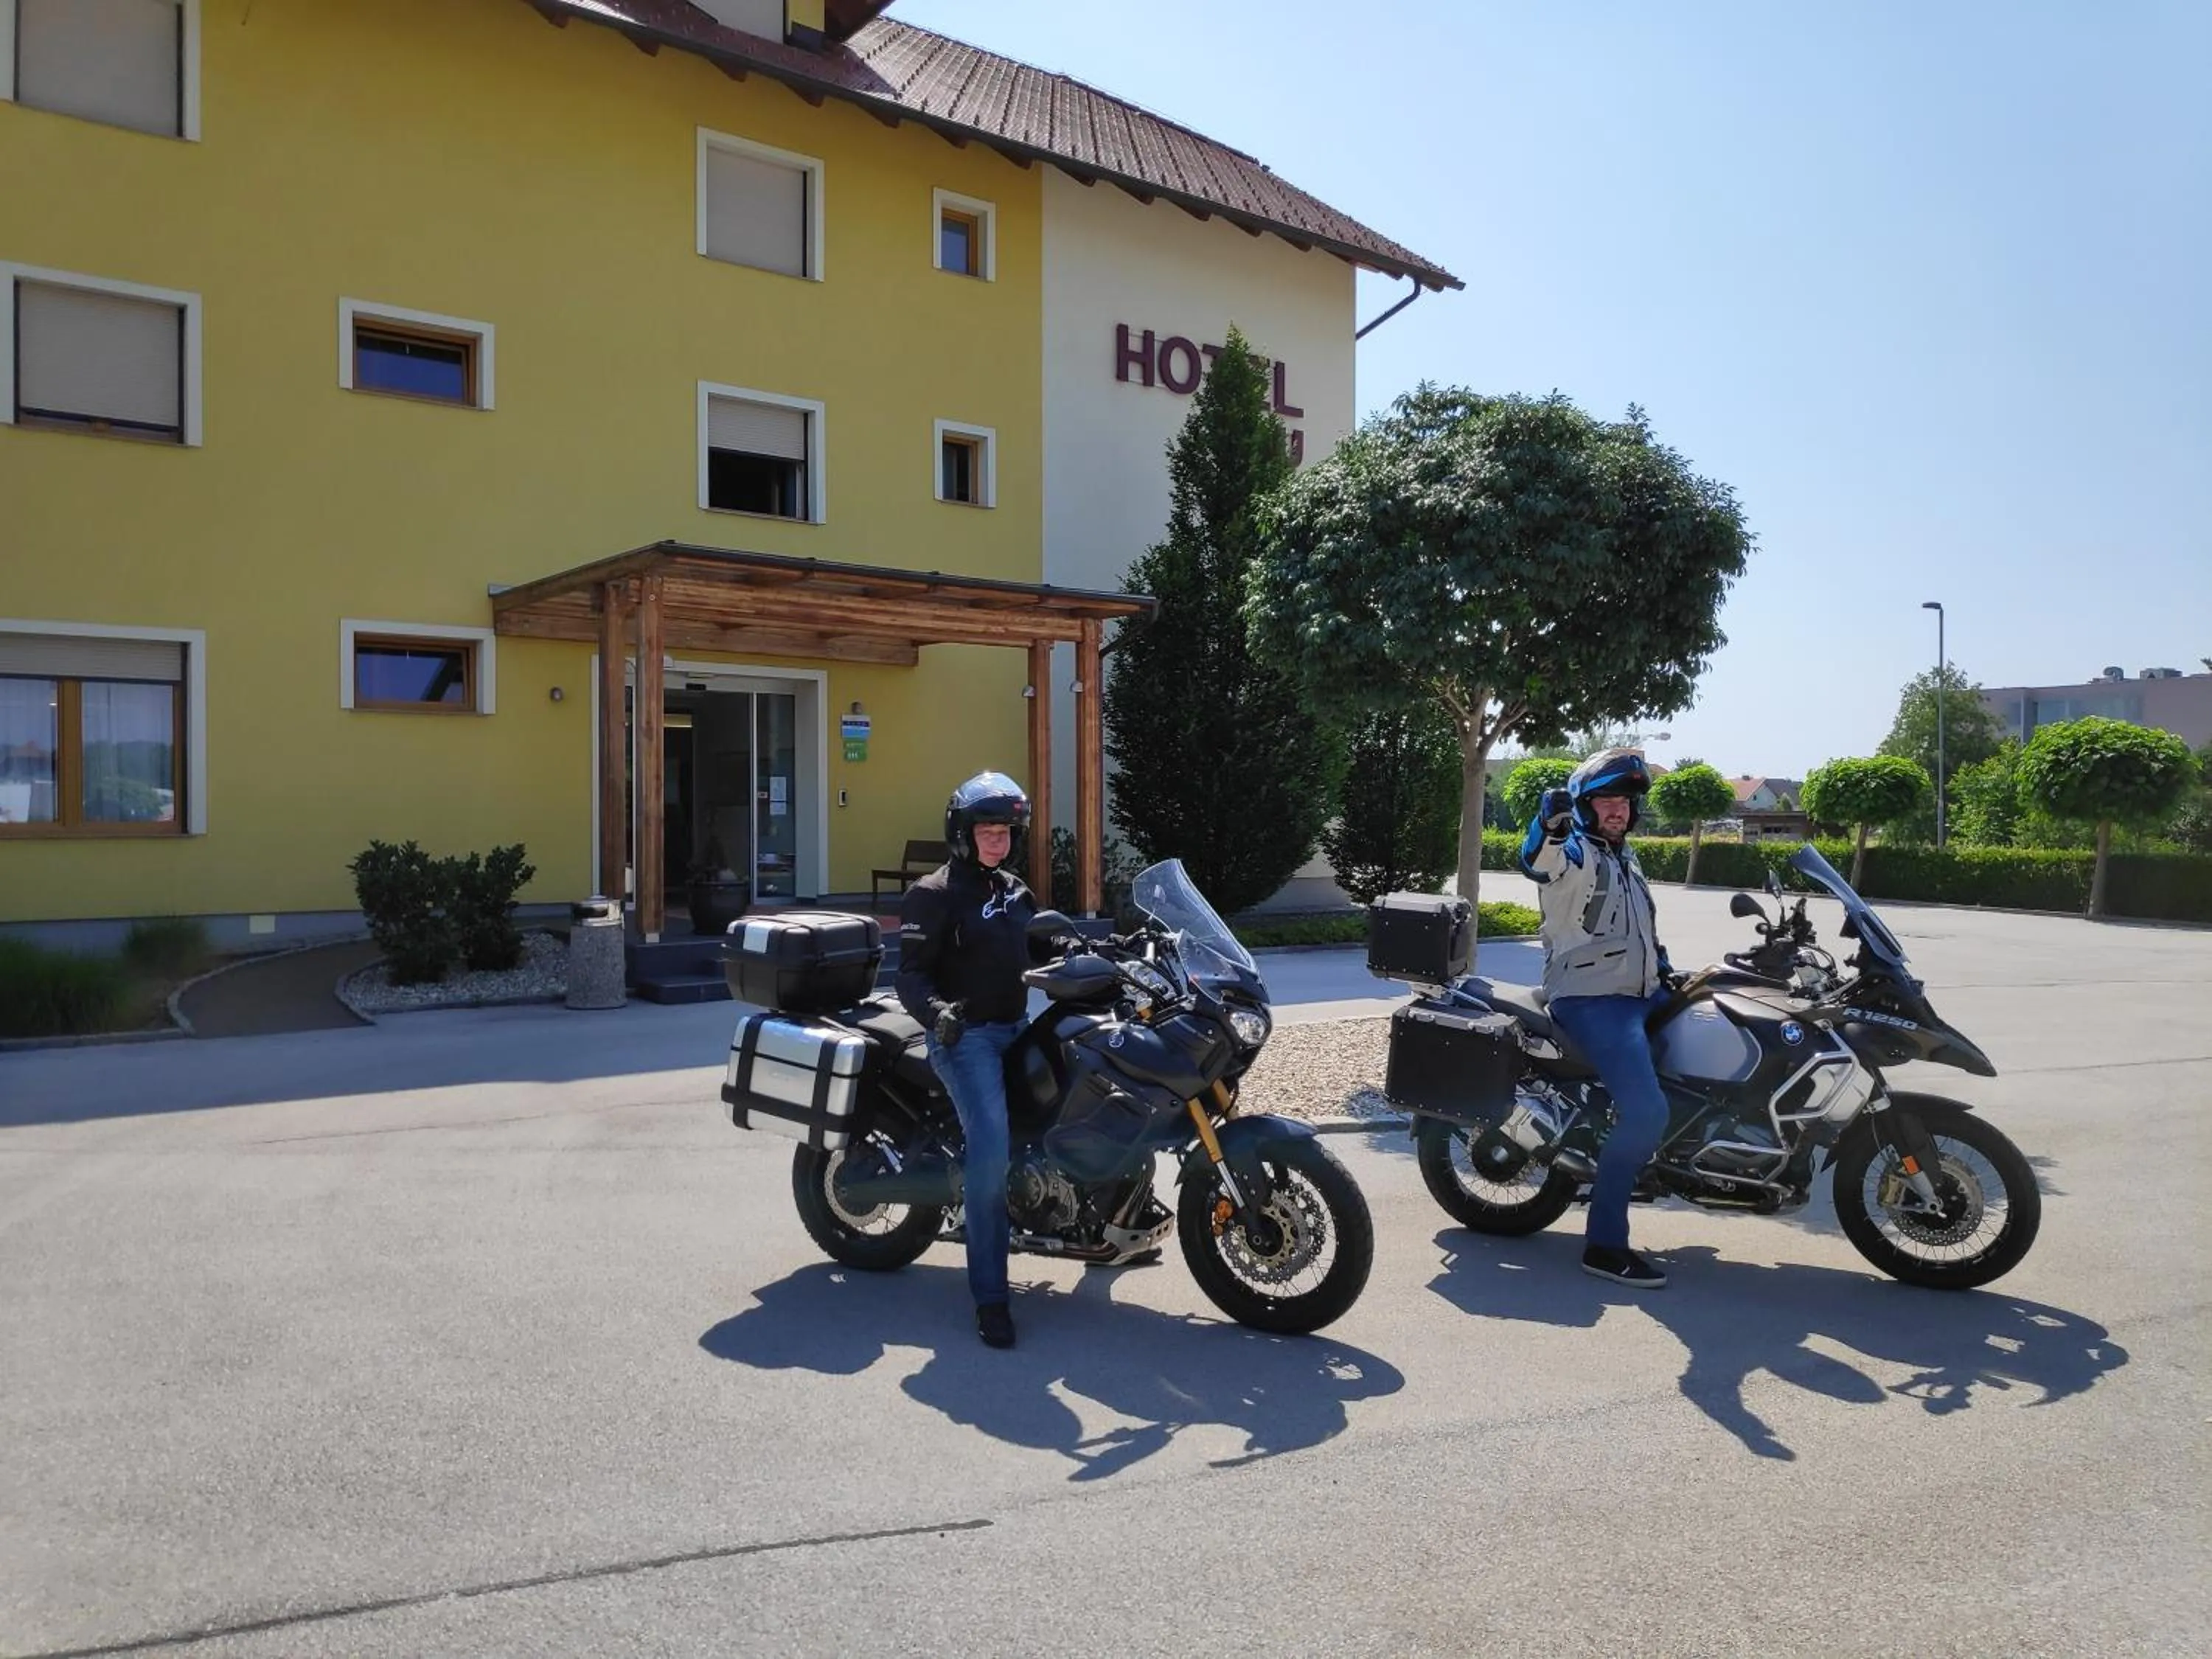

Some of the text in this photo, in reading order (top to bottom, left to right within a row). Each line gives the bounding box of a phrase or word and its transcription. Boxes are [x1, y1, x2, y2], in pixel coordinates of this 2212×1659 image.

[1116, 323, 1304, 418] HOL
[1843, 1007, 1919, 1030] R 1250
